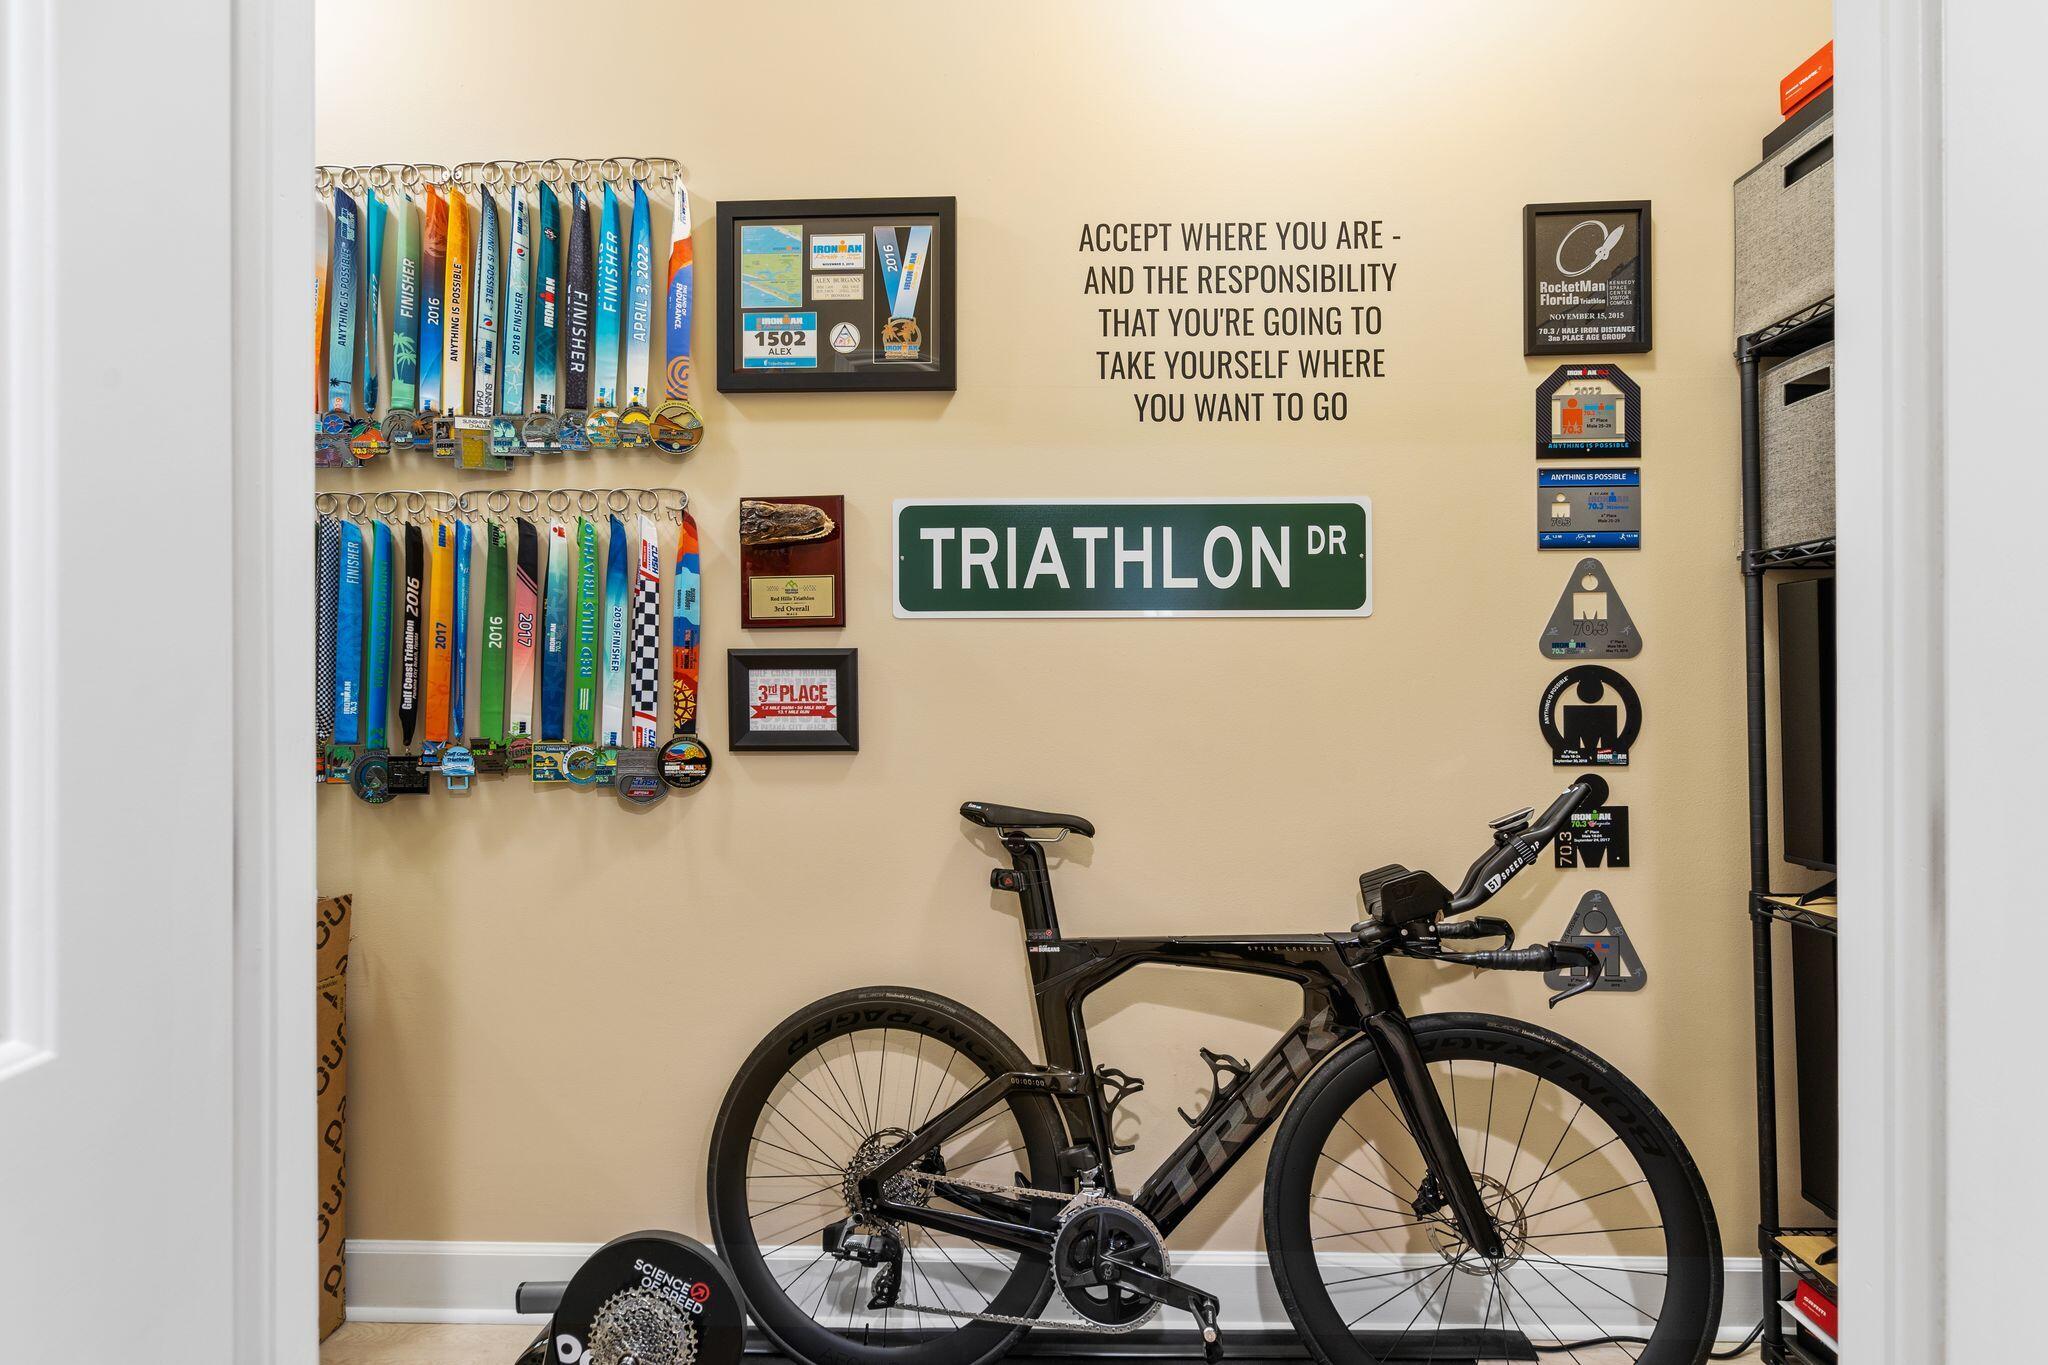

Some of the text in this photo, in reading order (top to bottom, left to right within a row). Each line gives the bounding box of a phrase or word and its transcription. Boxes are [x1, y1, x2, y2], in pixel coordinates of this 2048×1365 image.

[813, 241, 862, 253] IRONMAN
[1079, 223, 1172, 252] ACCEPT
[1181, 222, 1267, 251] WHERE
[1276, 221, 1327, 250] YOU
[1336, 220, 1383, 249] ARE
[603, 231, 618, 313] FINISHER
[637, 244, 649, 280] 2022
[883, 244, 898, 273] 2016
[904, 253, 918, 290] IRONMAN
[400, 258, 416, 319] FINISHER
[485, 264, 494, 304] POSSIBLE
[1084, 263, 1397, 295] AND THE RESPONSIBILITY
[1540, 280, 1606, 294] RocketMan
[338, 249, 350, 346] ANYTHING IS POSSIBLE
[427, 297, 440, 326] 2016
[451, 262, 463, 362] ANYTHING IS POSSIBLE
[541, 277, 555, 328] IRONMAN
[1540, 292, 1580, 306] Florida
[512, 292, 523, 356] 2018 FINISHER
[570, 290, 588, 372] FINISHER
[632, 301, 647, 343] APRIL
[762, 315, 803, 325] IRONMAN
[1098, 306, 1382, 337] THAT YOU'RE GOING TO
[754, 331, 806, 347] 1502
[768, 347, 792, 355] ALEX
[1096, 348, 1385, 380] TAKE YOURSELF WHERE
[1566, 368, 1597, 376] IRONMAN
[1133, 391, 1348, 422] YOU WANT TO GO
[1574, 387, 1602, 395] 2022
[1562, 426, 1583, 434] 70.3
[1551, 517, 1572, 527] 70.3
[346, 541, 360, 585] FINISHER
[651, 545, 659, 575] CLASH
[919, 525, 1347, 590] TRIATHLON DR
[435, 622, 447, 650] 2017
[489, 616, 503, 648] 2016
[517, 613, 533, 647] 2017
[582, 602, 595, 641] HILLS
[1573, 620, 1608, 636] 70.3
[402, 576, 420, 710] Gulf Coast Triathlon 2016
[610, 606, 622, 673] 2019 FINISHER
[580, 647, 593, 676] RED
[342, 681, 351, 714] IRONMAN
[758, 684, 828, 702] 3rd PLACE
[1551, 676, 1569, 695] POSSIBLE
[350, 701, 358, 715] 70.3
[1571, 812, 1612, 820] IRONMAN
[1559, 831, 1572, 866] 70.3
[1488, 857, 1524, 890] 51 SPEED
[1570, 1050, 1608, 1073] EDITION
[1153, 1004, 1340, 1207] TREK
[634, 1259, 691, 1296] SCIENCE
[661, 1286, 703, 1315] SPEED
